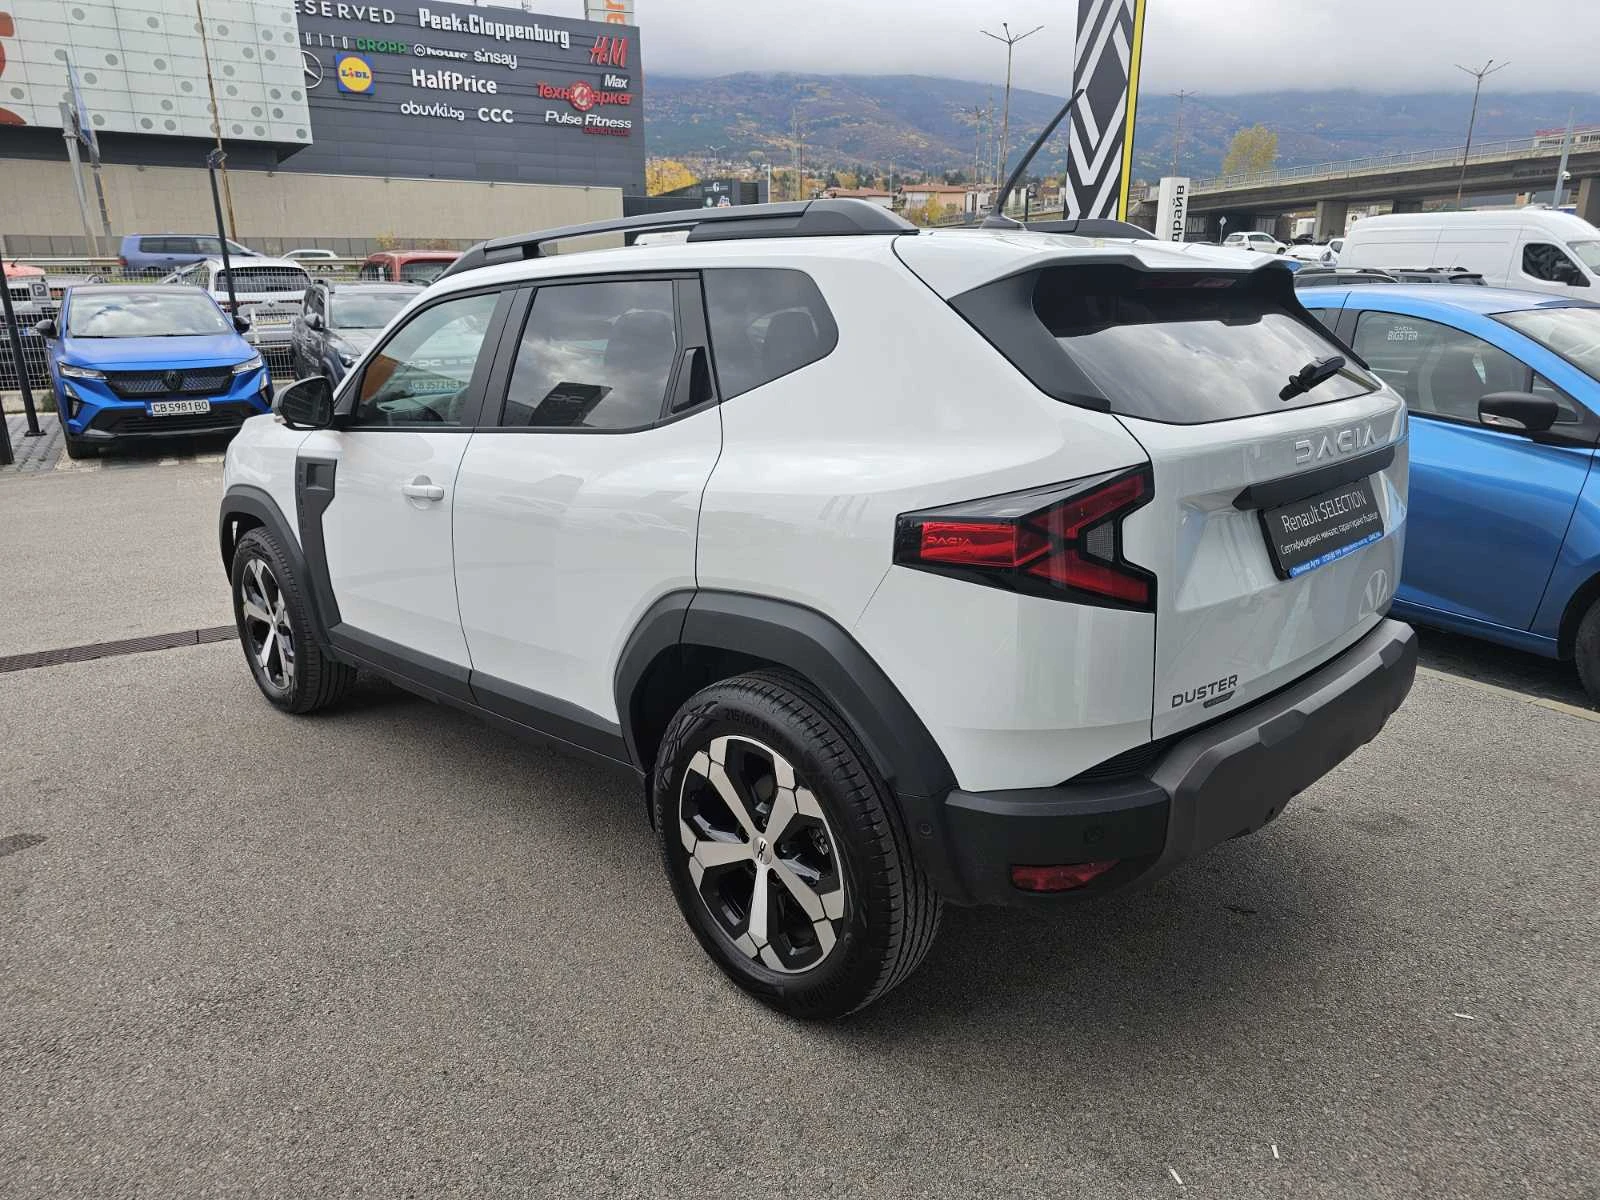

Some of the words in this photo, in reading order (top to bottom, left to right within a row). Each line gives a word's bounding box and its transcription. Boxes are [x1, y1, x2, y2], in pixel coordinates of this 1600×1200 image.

[418, 7, 570, 49] Peek&Cloppenburg
[356, 38, 407, 53] CROPP
[411, 68, 497, 95] HalfPrice
[604, 74, 628, 89] Max
[400, 101, 465, 121] obuvki.bg
[478, 107, 514, 124] CCC
[545, 110, 582, 125] Pulse
[584, 113, 632, 129] Fitness
[1295, 424, 1376, 465] DACIA
[1281, 504, 1322, 533] Renault
[1320, 489, 1368, 520] SELECTION
[1171, 674, 1238, 708] DUSTER
